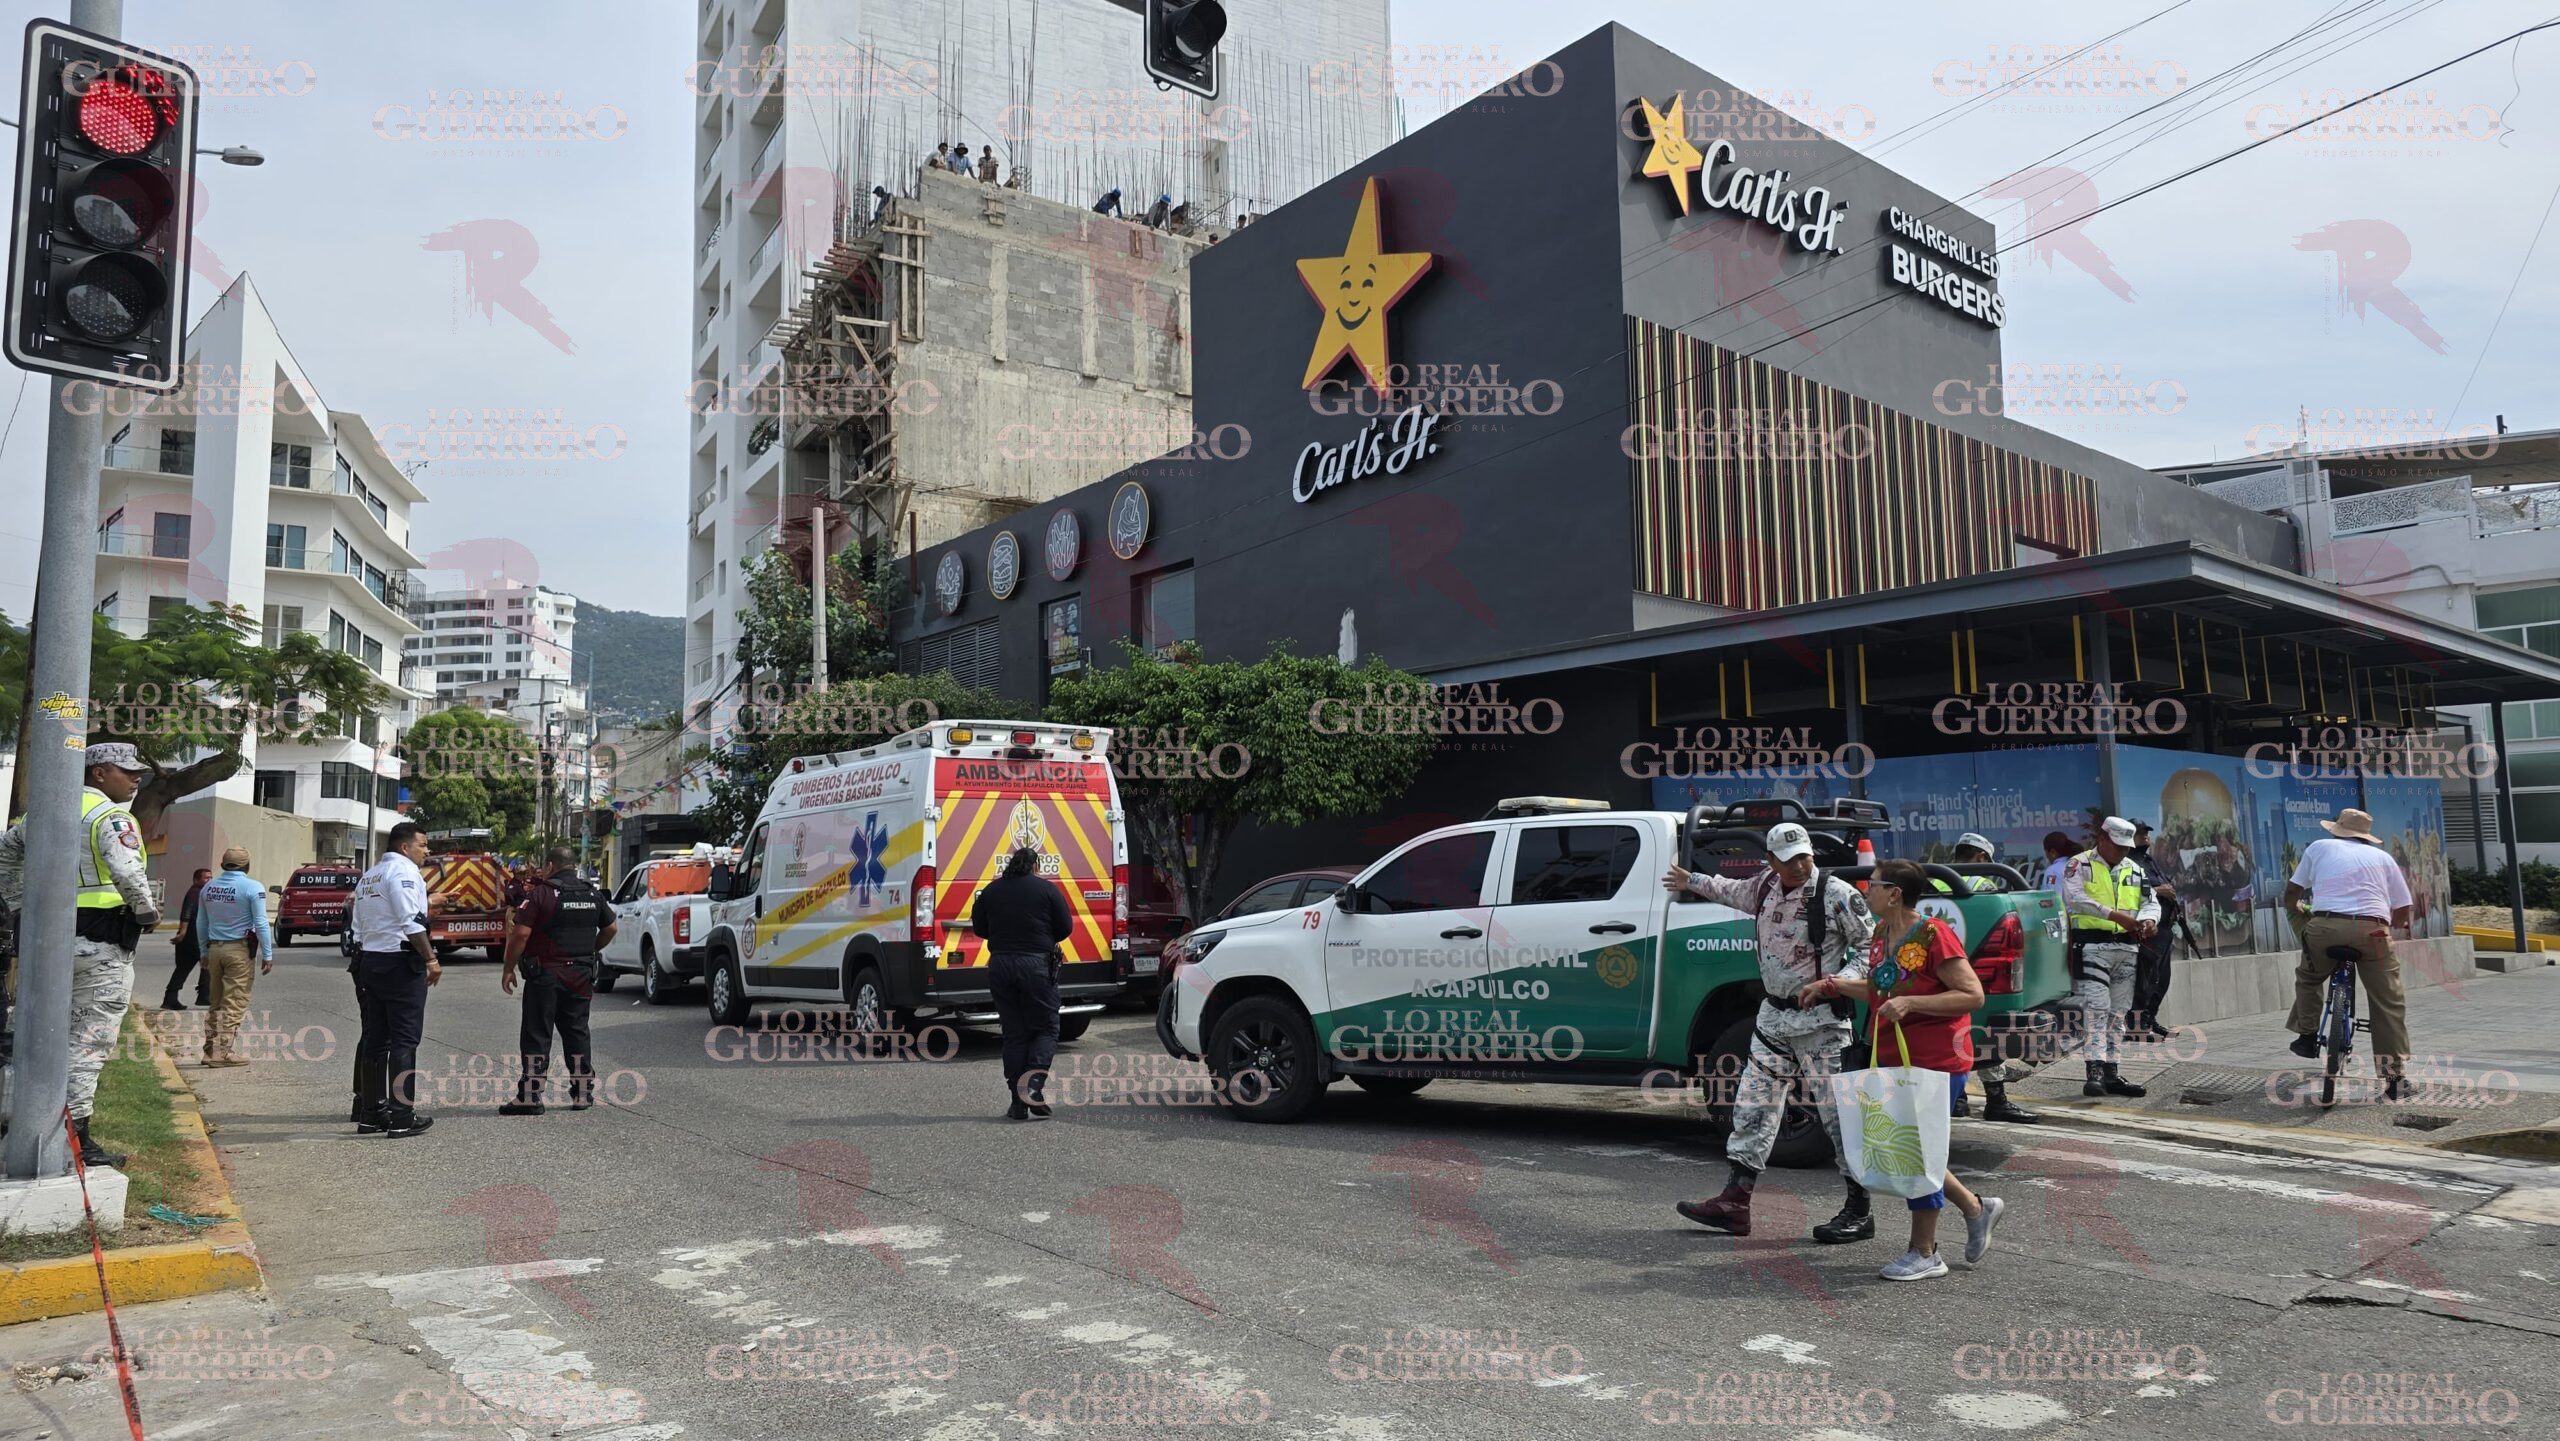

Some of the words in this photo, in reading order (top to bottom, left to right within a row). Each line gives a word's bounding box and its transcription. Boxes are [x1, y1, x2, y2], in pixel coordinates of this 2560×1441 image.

[1702, 139, 1797, 233] Carl's
[1798, 185, 1845, 256] Jr.
[1890, 205, 2001, 281] CHARGRILLED
[1891, 243, 2007, 329] BURGERS
[1292, 418, 1382, 504] Carl's
[1385, 403, 1440, 475] Jr.
[790, 773, 843, 797] BOMBEROS
[844, 762, 902, 787] ACAPULCO
[955, 764, 1088, 783] AMBULANCIA
[799, 790, 844, 809] URGENCIAS
[844, 784, 883, 803] BASICAS
[1927, 793, 1963, 812] Hand
[1964, 788, 2023, 810] Scooped
[1908, 810, 1965, 832] Cream
[1967, 805, 2008, 830] Milk
[2010, 804, 2080, 829] Shakes
[785, 861, 808, 871] BOMBEROS
[995, 853, 1060, 865] BOROS
[1719, 858, 1762, 868] HILUX
[784, 869, 807, 878] ACAPULCO
[996, 864, 1060, 875] ALCO
[300, 876, 358, 884] BOMBEOS
[207, 886, 237, 896] POLICÍA
[778, 894, 806, 924] MUNICIPIO
[806, 889, 815, 905] DE
[815, 871, 847, 903] ACAPULCO
[888, 889, 901, 905] 74
[447, 921, 504, 933] BOMBEROS
[1302, 911, 1321, 930] 79
[1686, 937, 1760, 952] COMAND
[1351, 944, 1513, 969] PROTECCIÓN
[1410, 979, 1551, 1001] ACAPULCO
